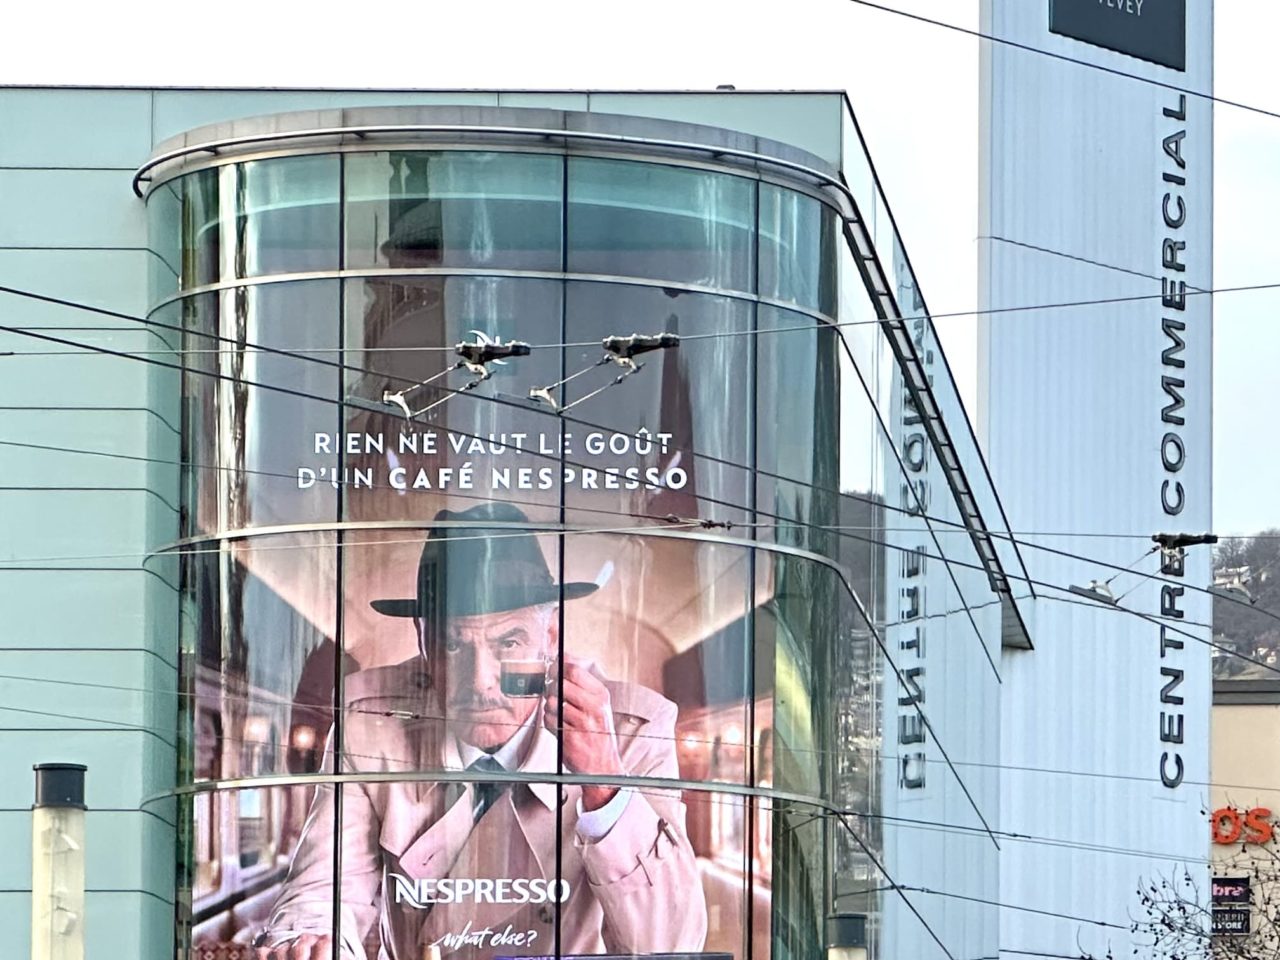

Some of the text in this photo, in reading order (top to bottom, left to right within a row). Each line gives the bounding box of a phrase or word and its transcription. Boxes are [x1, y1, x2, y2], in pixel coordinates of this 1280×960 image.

[314, 426, 672, 455] RIEN NE VAUT LE GOÛT
[1160, 94, 1186, 789] CENTRE COMMERCIAL
[389, 461, 473, 489] CAFÉ
[492, 467, 687, 490] NESPRESSO
[389, 873, 571, 909] NESPRESSO
[429, 920, 537, 950] what else?
